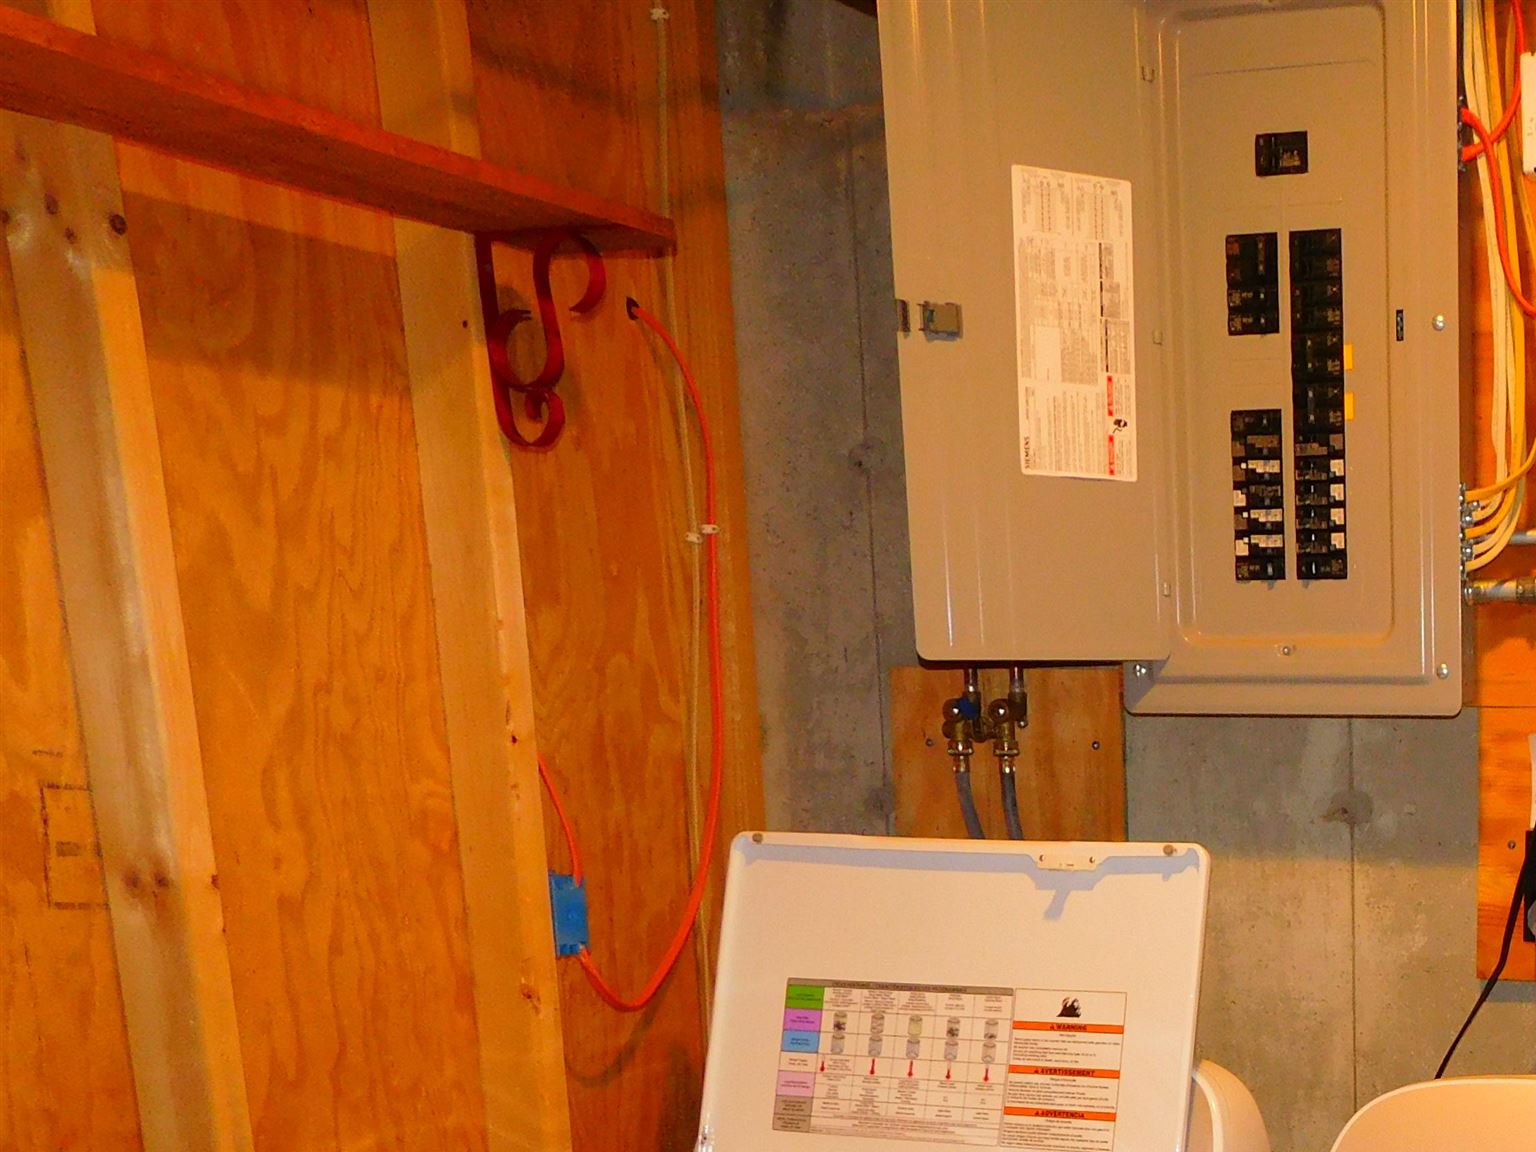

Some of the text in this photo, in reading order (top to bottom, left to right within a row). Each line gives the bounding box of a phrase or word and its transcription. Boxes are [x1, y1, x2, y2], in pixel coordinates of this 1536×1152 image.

[1056, 1022, 1087, 1031] WARNING
[1041, 1068, 1096, 1077] AVERTISSEMENT
[1041, 1110, 1085, 1119] ADVERTENCIA
